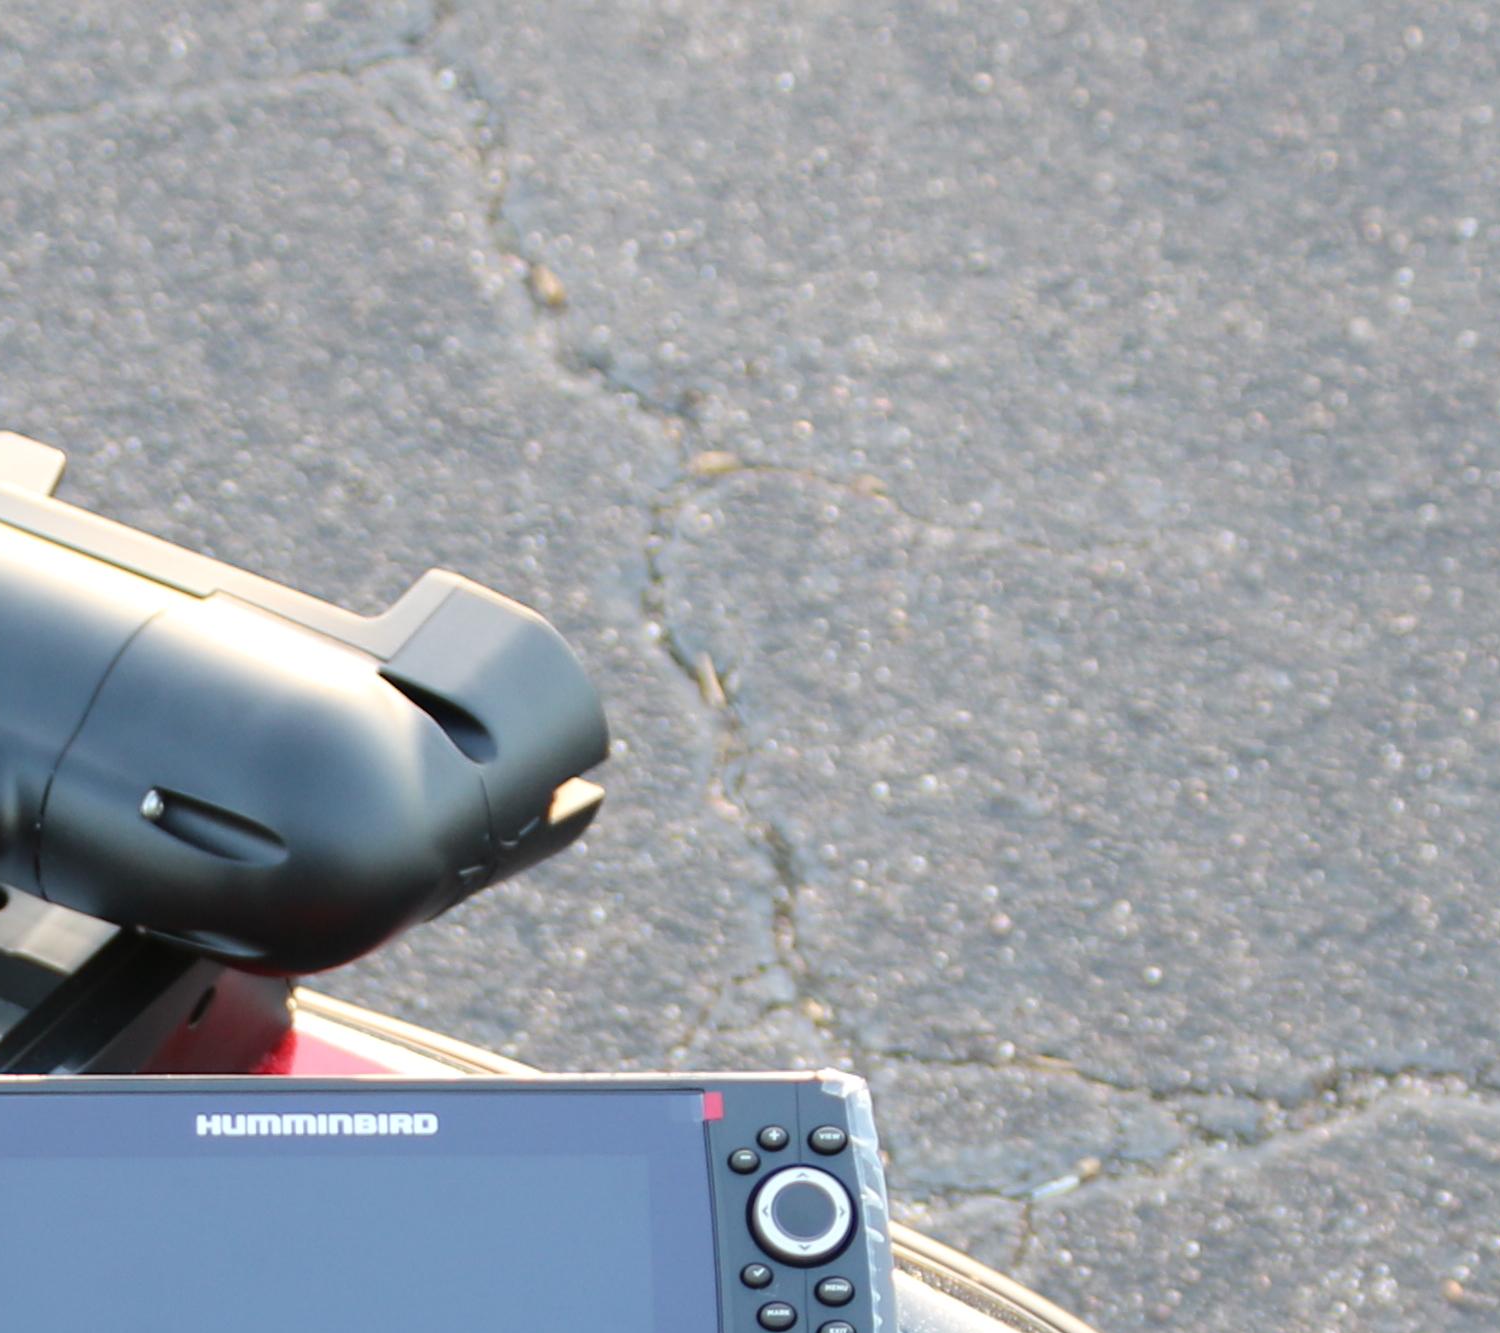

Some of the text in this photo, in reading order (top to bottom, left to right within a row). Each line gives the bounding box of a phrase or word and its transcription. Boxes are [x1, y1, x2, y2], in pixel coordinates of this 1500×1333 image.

[196, 1113, 439, 1136] HUMMINBIRD
[824, 1284, 849, 1292] MENU
[766, 1309, 791, 1317] MARK
